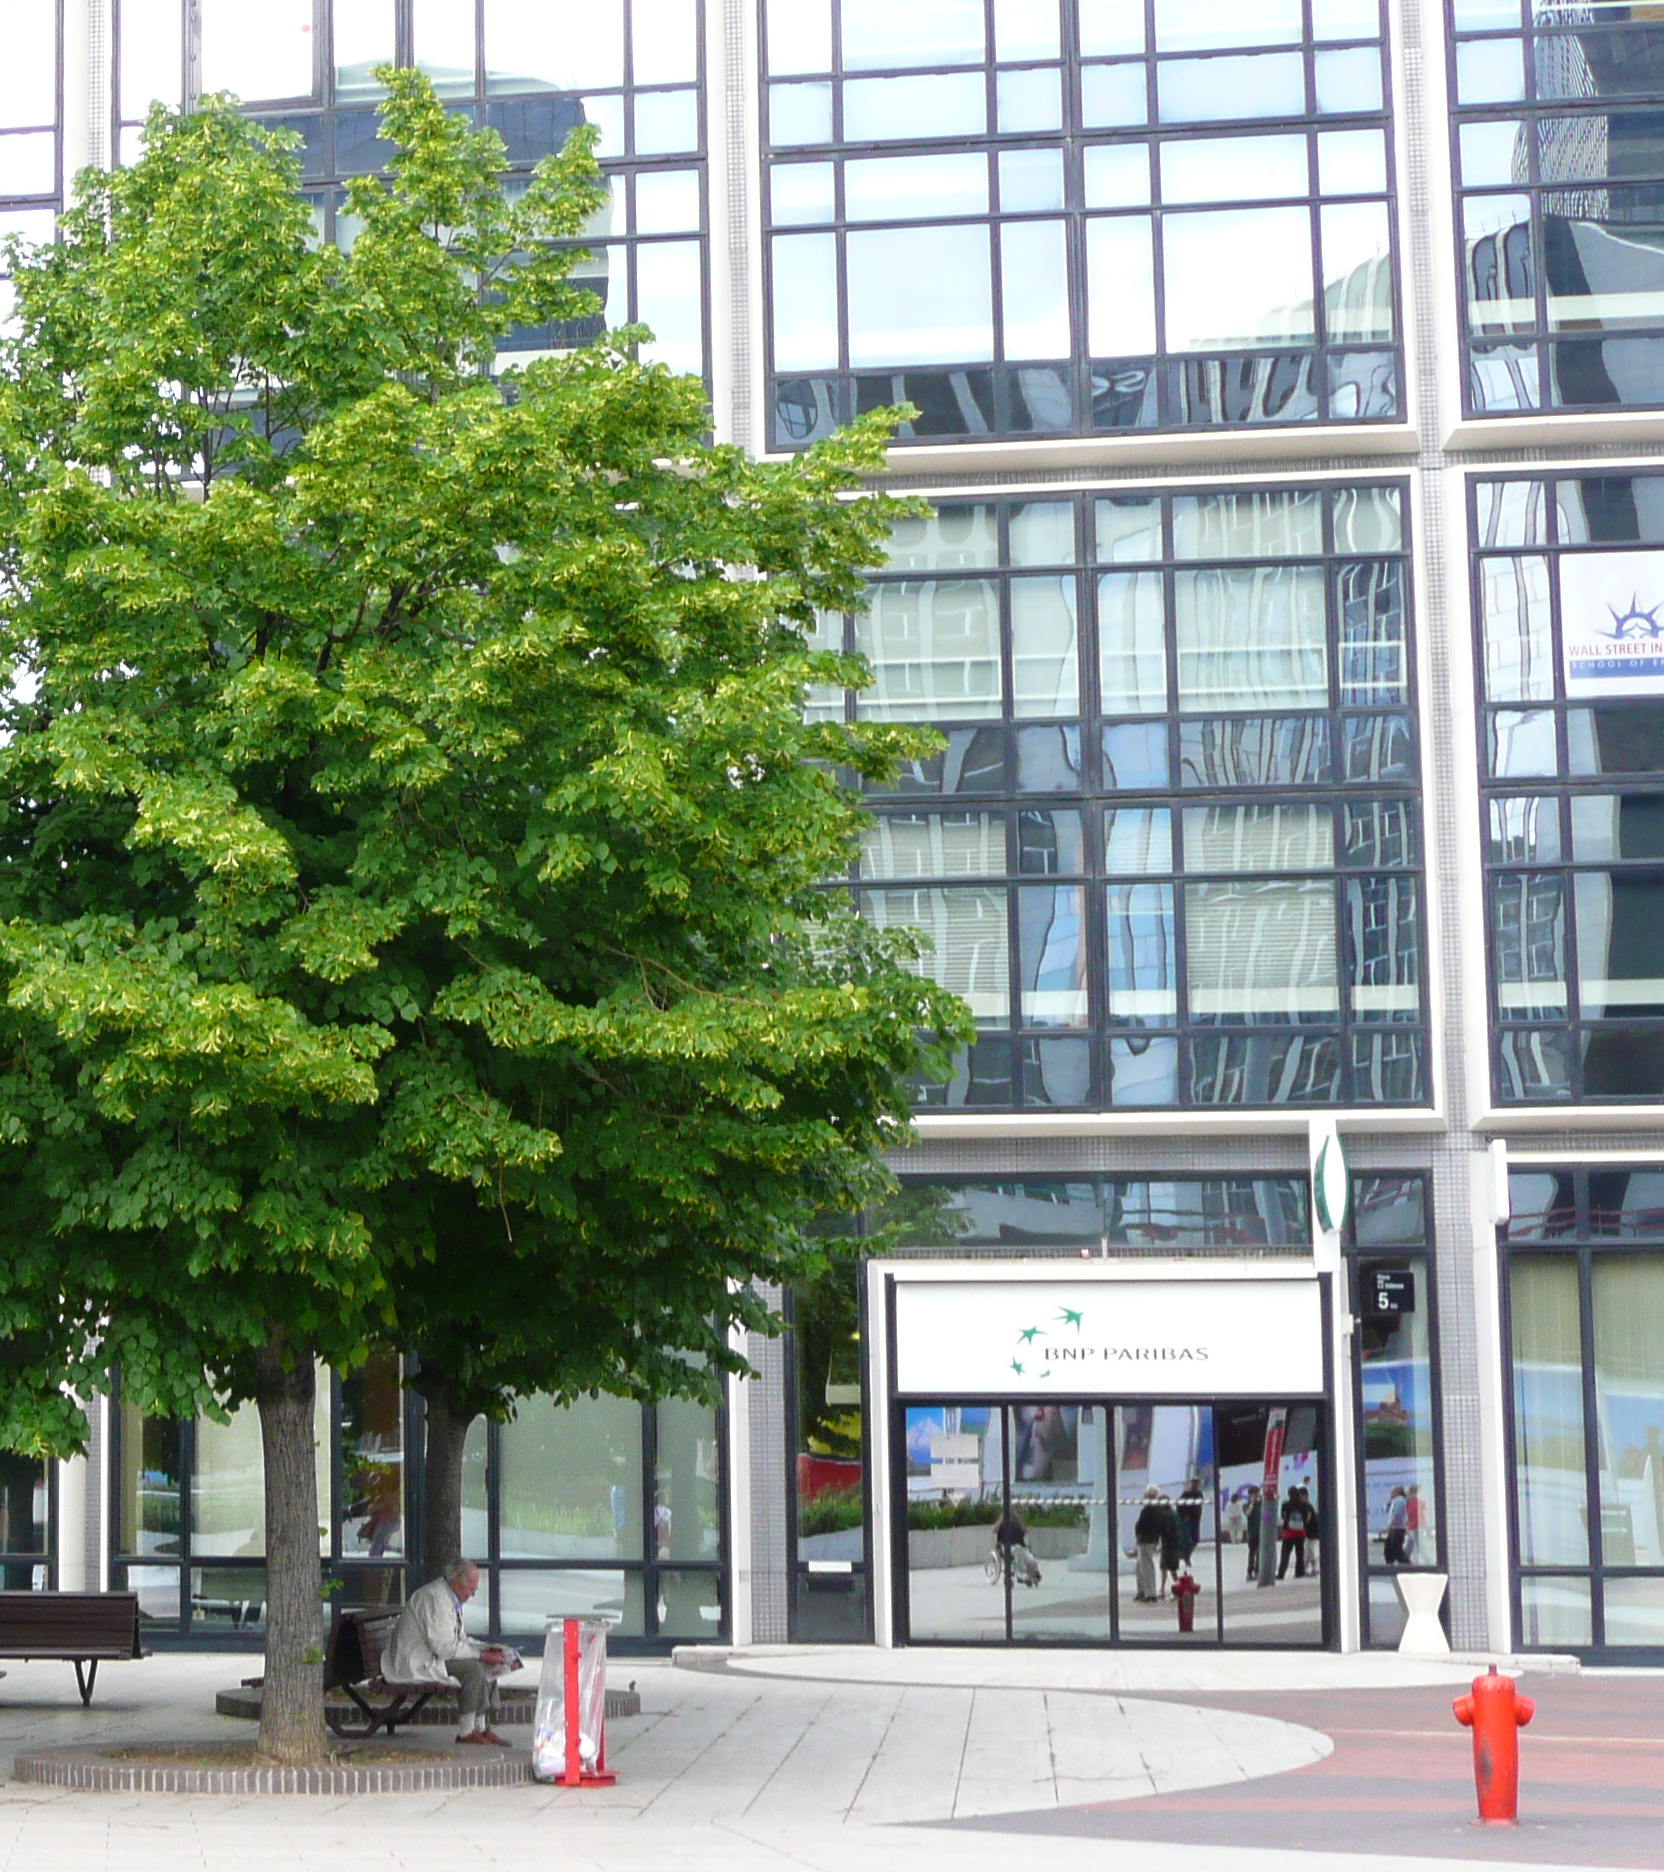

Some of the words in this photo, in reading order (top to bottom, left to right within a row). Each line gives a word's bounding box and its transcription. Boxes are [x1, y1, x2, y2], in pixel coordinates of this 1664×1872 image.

[1569, 644, 1601, 656] WALL
[1605, 642, 1647, 655] STREET
[1571, 660, 1621, 669] SCHOOL
[1378, 1291, 1389, 1310] 5
[1045, 1347, 1095, 1360] BNP
[1103, 1347, 1209, 1361] PARIBAS
